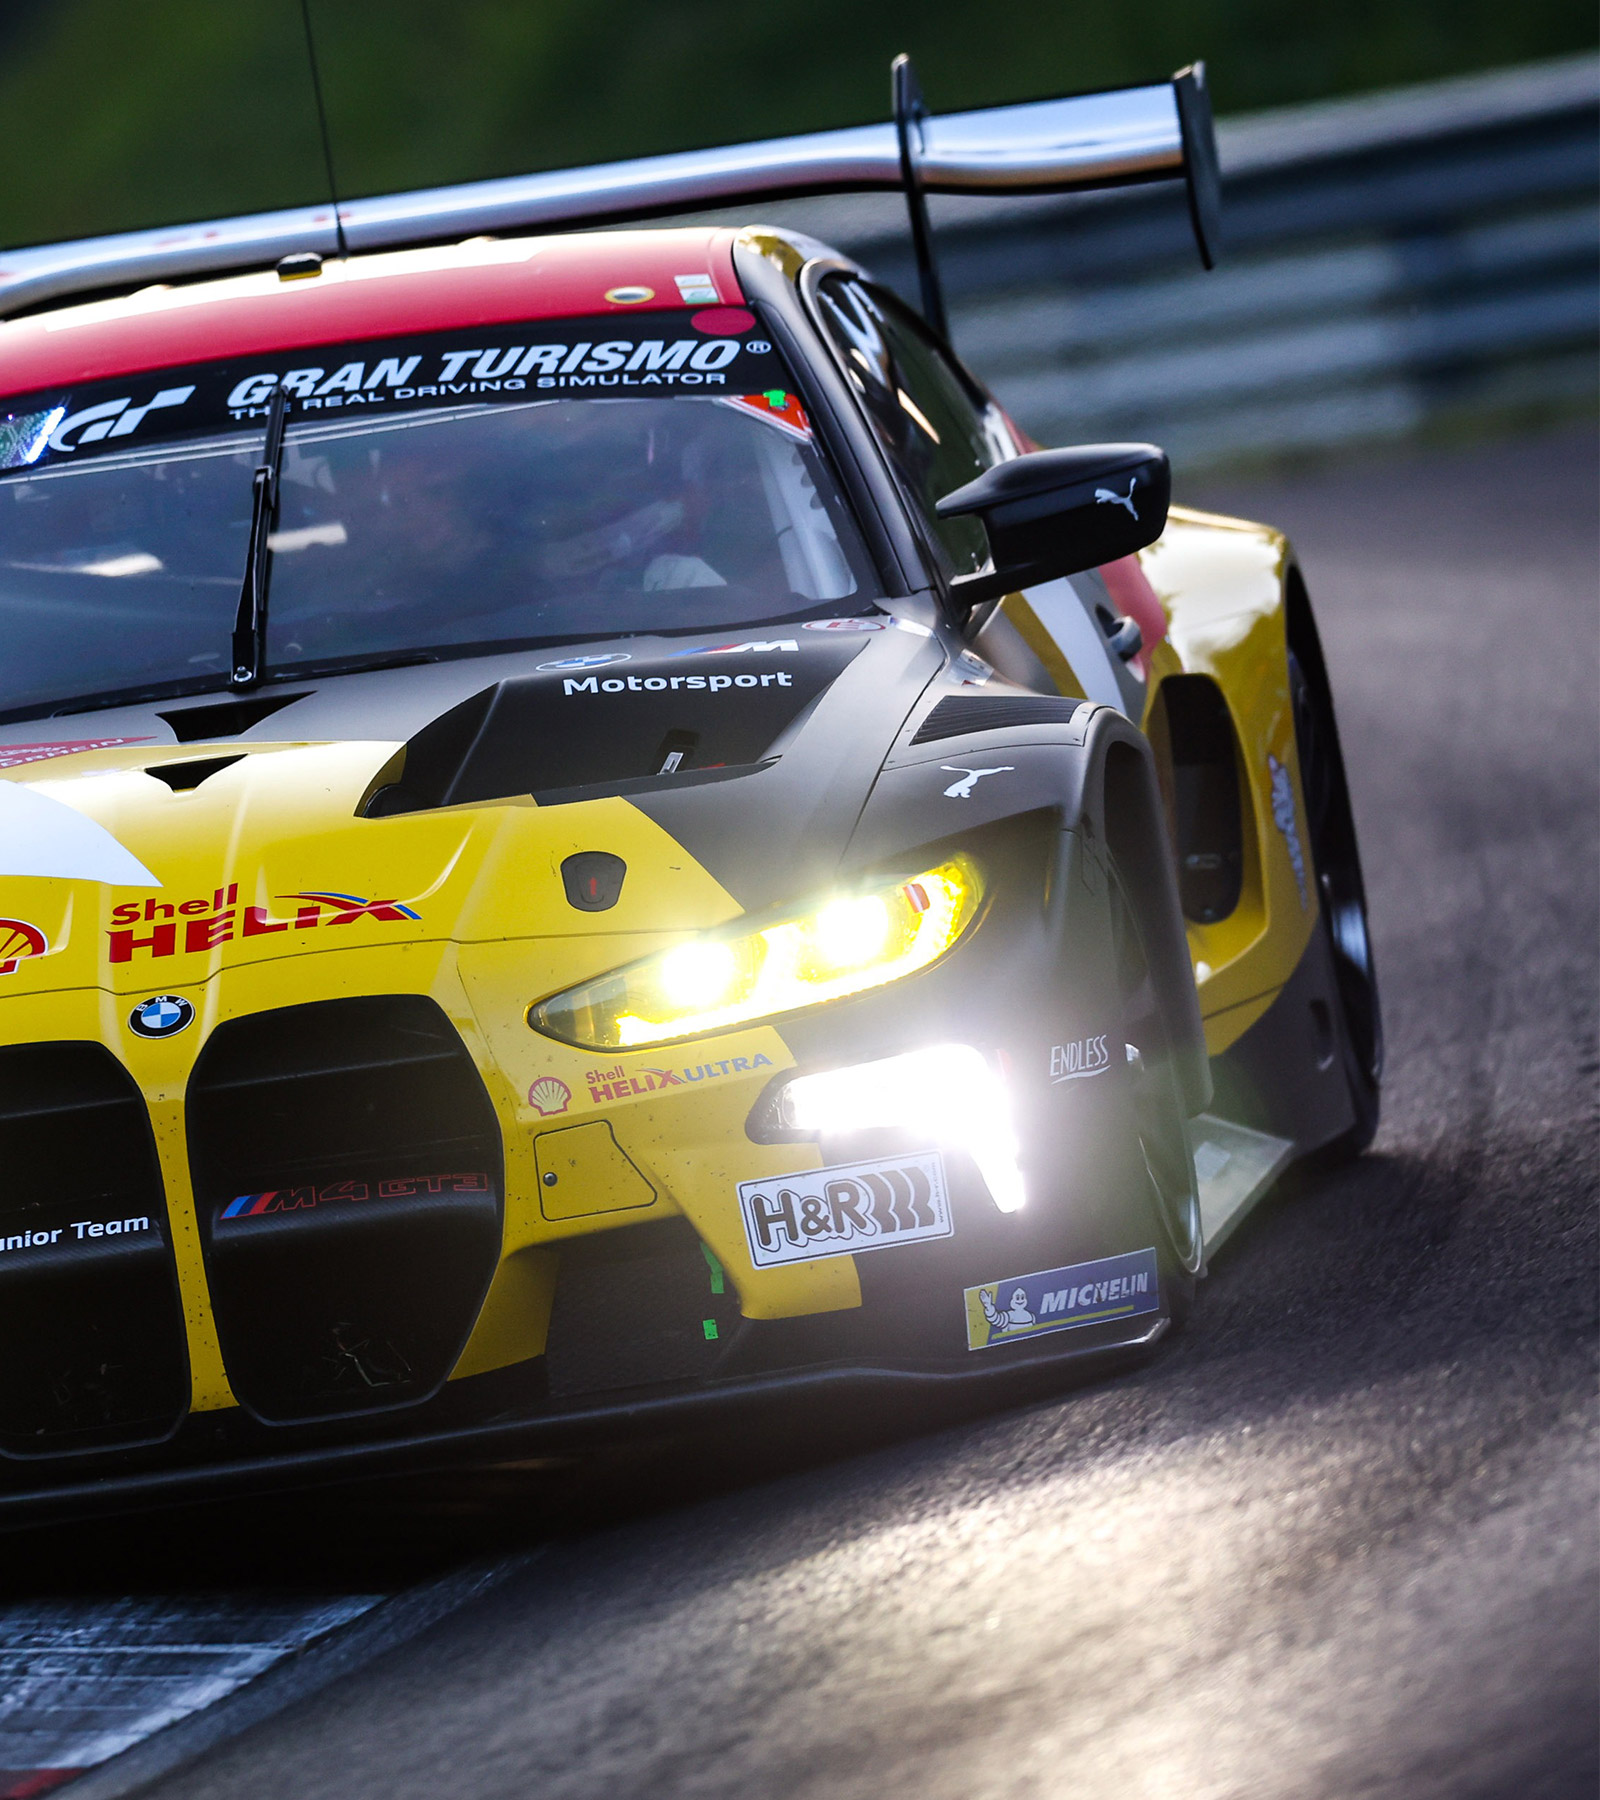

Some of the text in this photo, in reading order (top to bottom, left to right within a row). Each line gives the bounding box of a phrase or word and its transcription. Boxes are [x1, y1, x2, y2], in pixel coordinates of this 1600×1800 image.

[226, 354, 423, 408] GRAN
[302, 392, 386, 412] REAL
[394, 378, 527, 400] DRIVING
[536, 372, 726, 389] SIMULATOR
[563, 670, 793, 697] Motorsport
[110, 882, 239, 926] Shell
[104, 892, 423, 964] HELIX
[135, 995, 188, 1012] BMW
[585, 1065, 626, 1085] Shell
[1050, 1034, 1109, 1077] ENDLESS
[588, 1053, 773, 1104] HELIX ULTRA
[262, 1172, 489, 1214] M4 GT3
[752, 1181, 870, 1247] H&R
[70, 1215, 149, 1239] Team
[1039, 1271, 1149, 1315] MICHELIN
